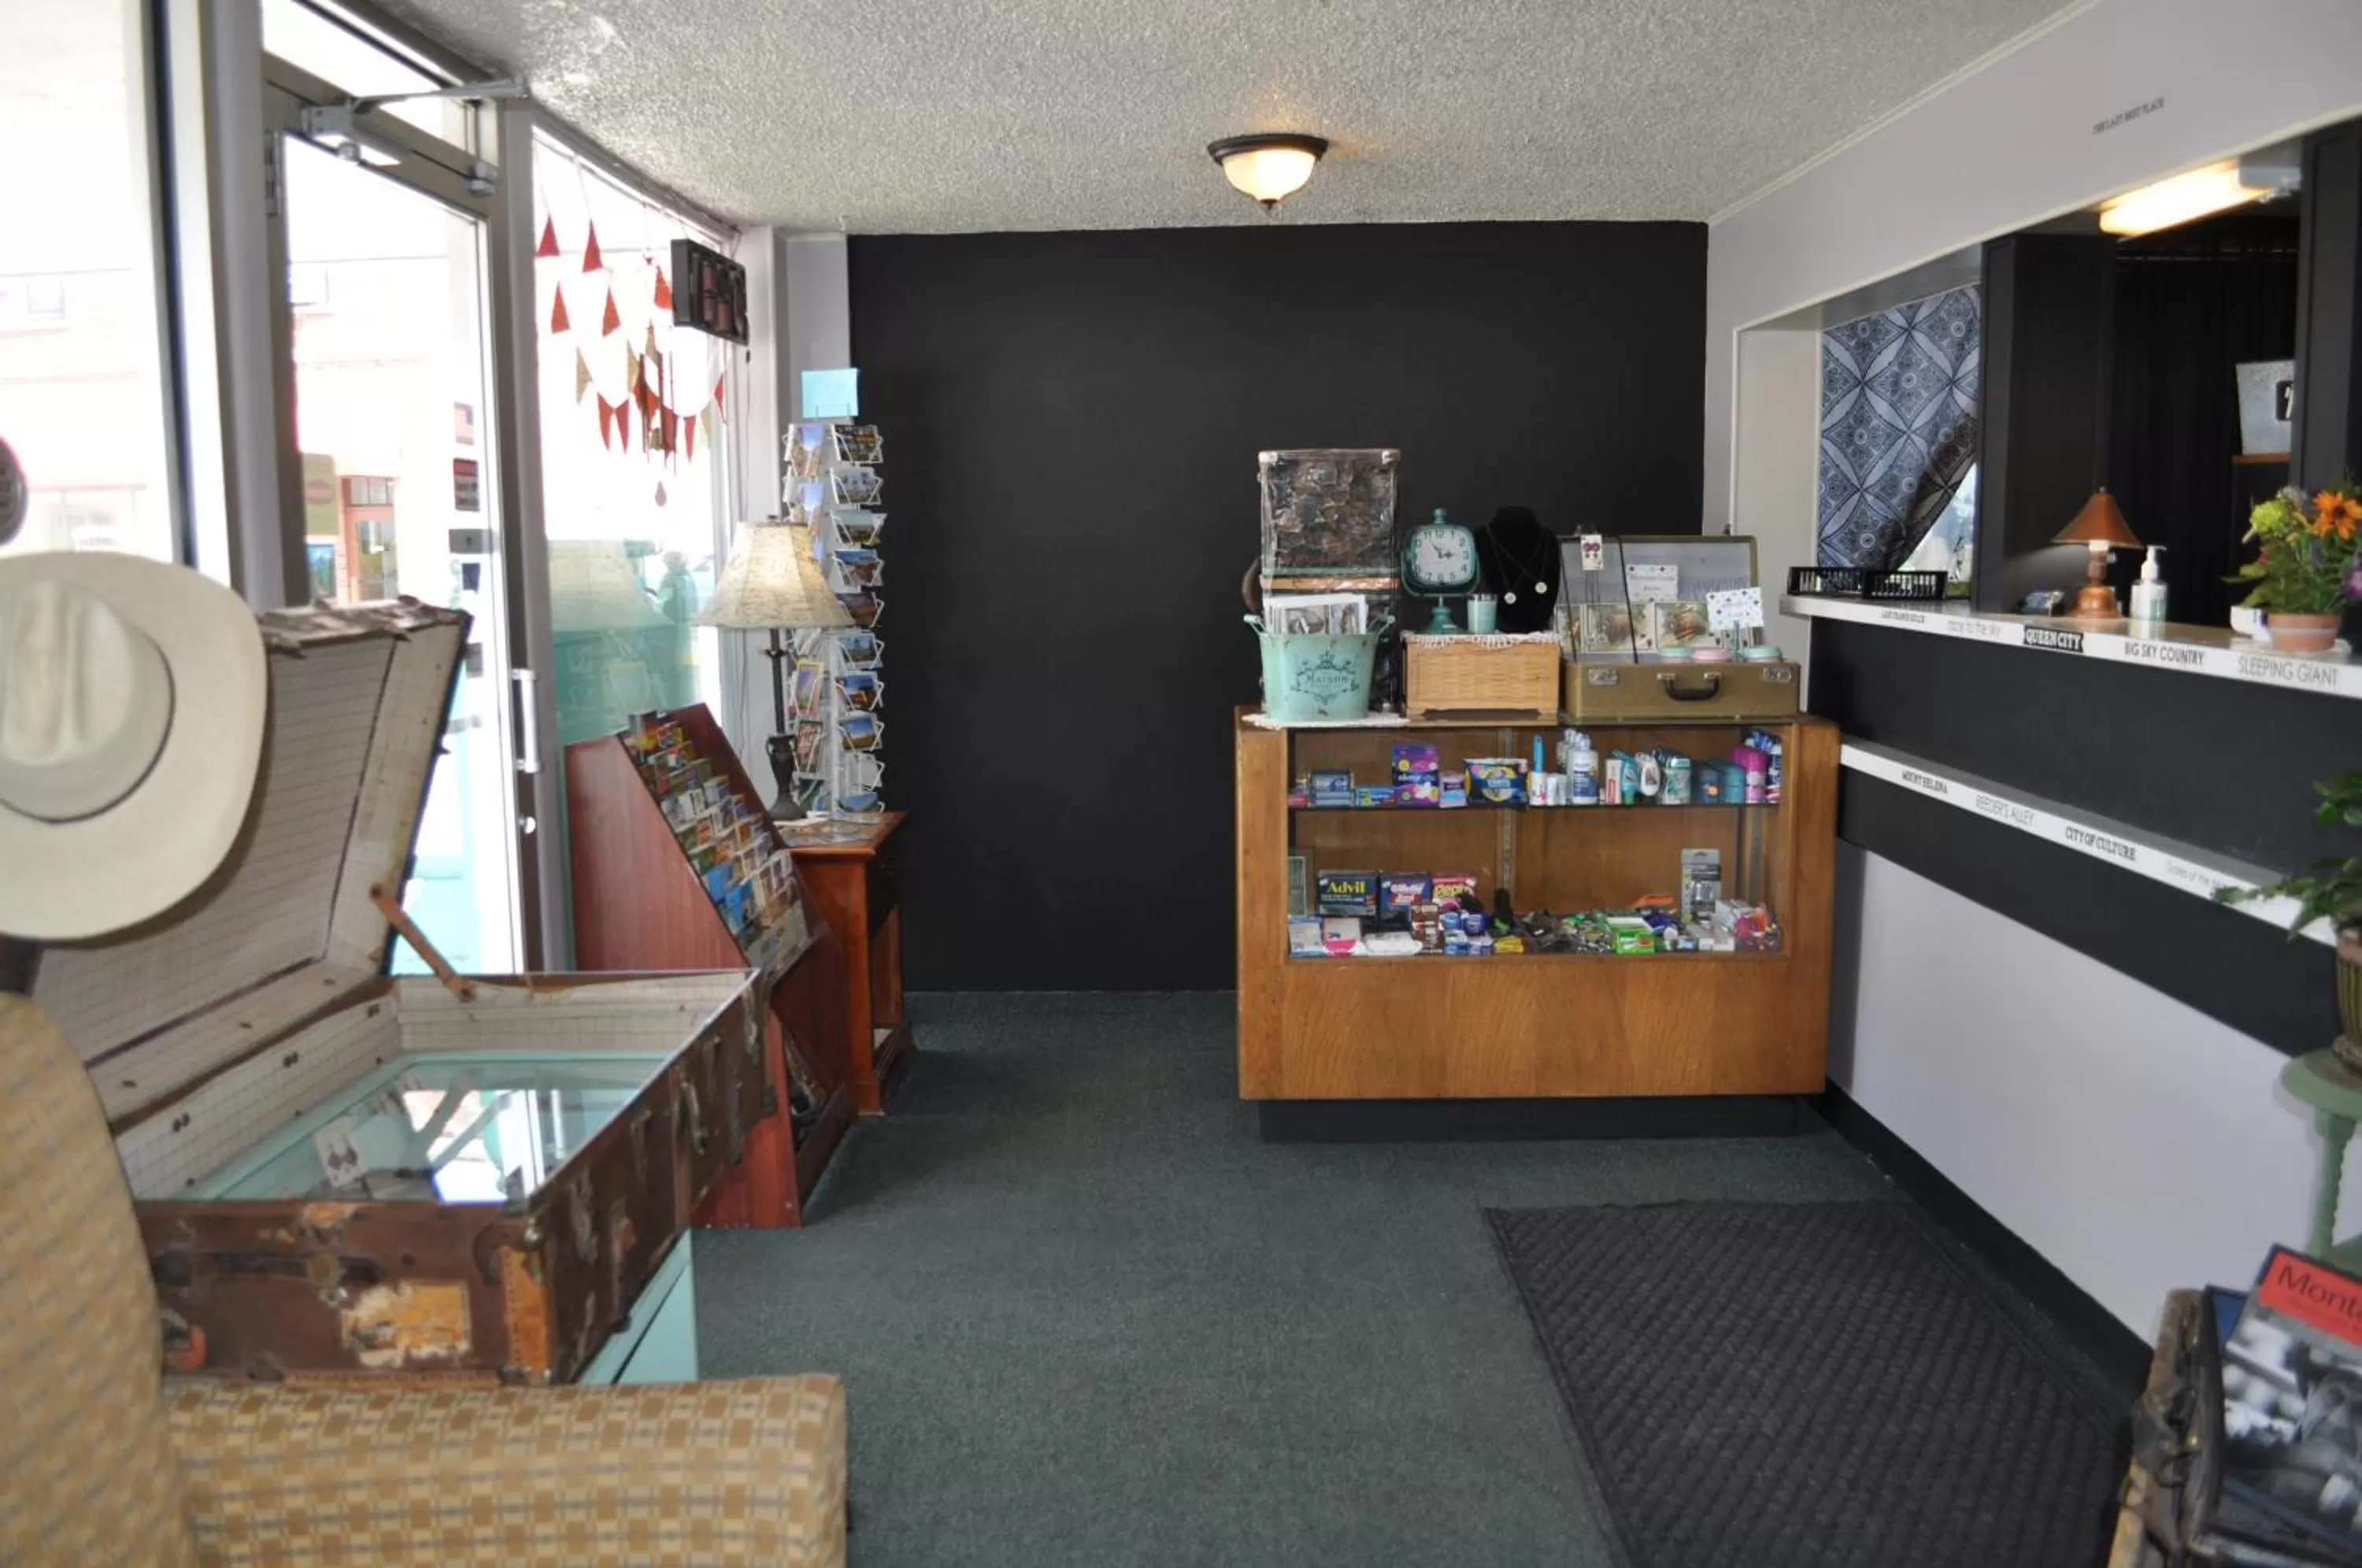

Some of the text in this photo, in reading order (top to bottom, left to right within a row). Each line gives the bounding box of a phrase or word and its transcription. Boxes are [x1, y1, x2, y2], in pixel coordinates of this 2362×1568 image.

[2026, 627, 2082, 651] QUEEN CITY
[2124, 642, 2205, 667] BIG SKY COUNTRY
[2238, 655, 2338, 686] SLEEPING GIANT
[2011, 805, 2035, 826] ALLEY
[2065, 826, 2136, 861] CITY OF CULTURE
[1326, 880, 1366, 894] Advil
